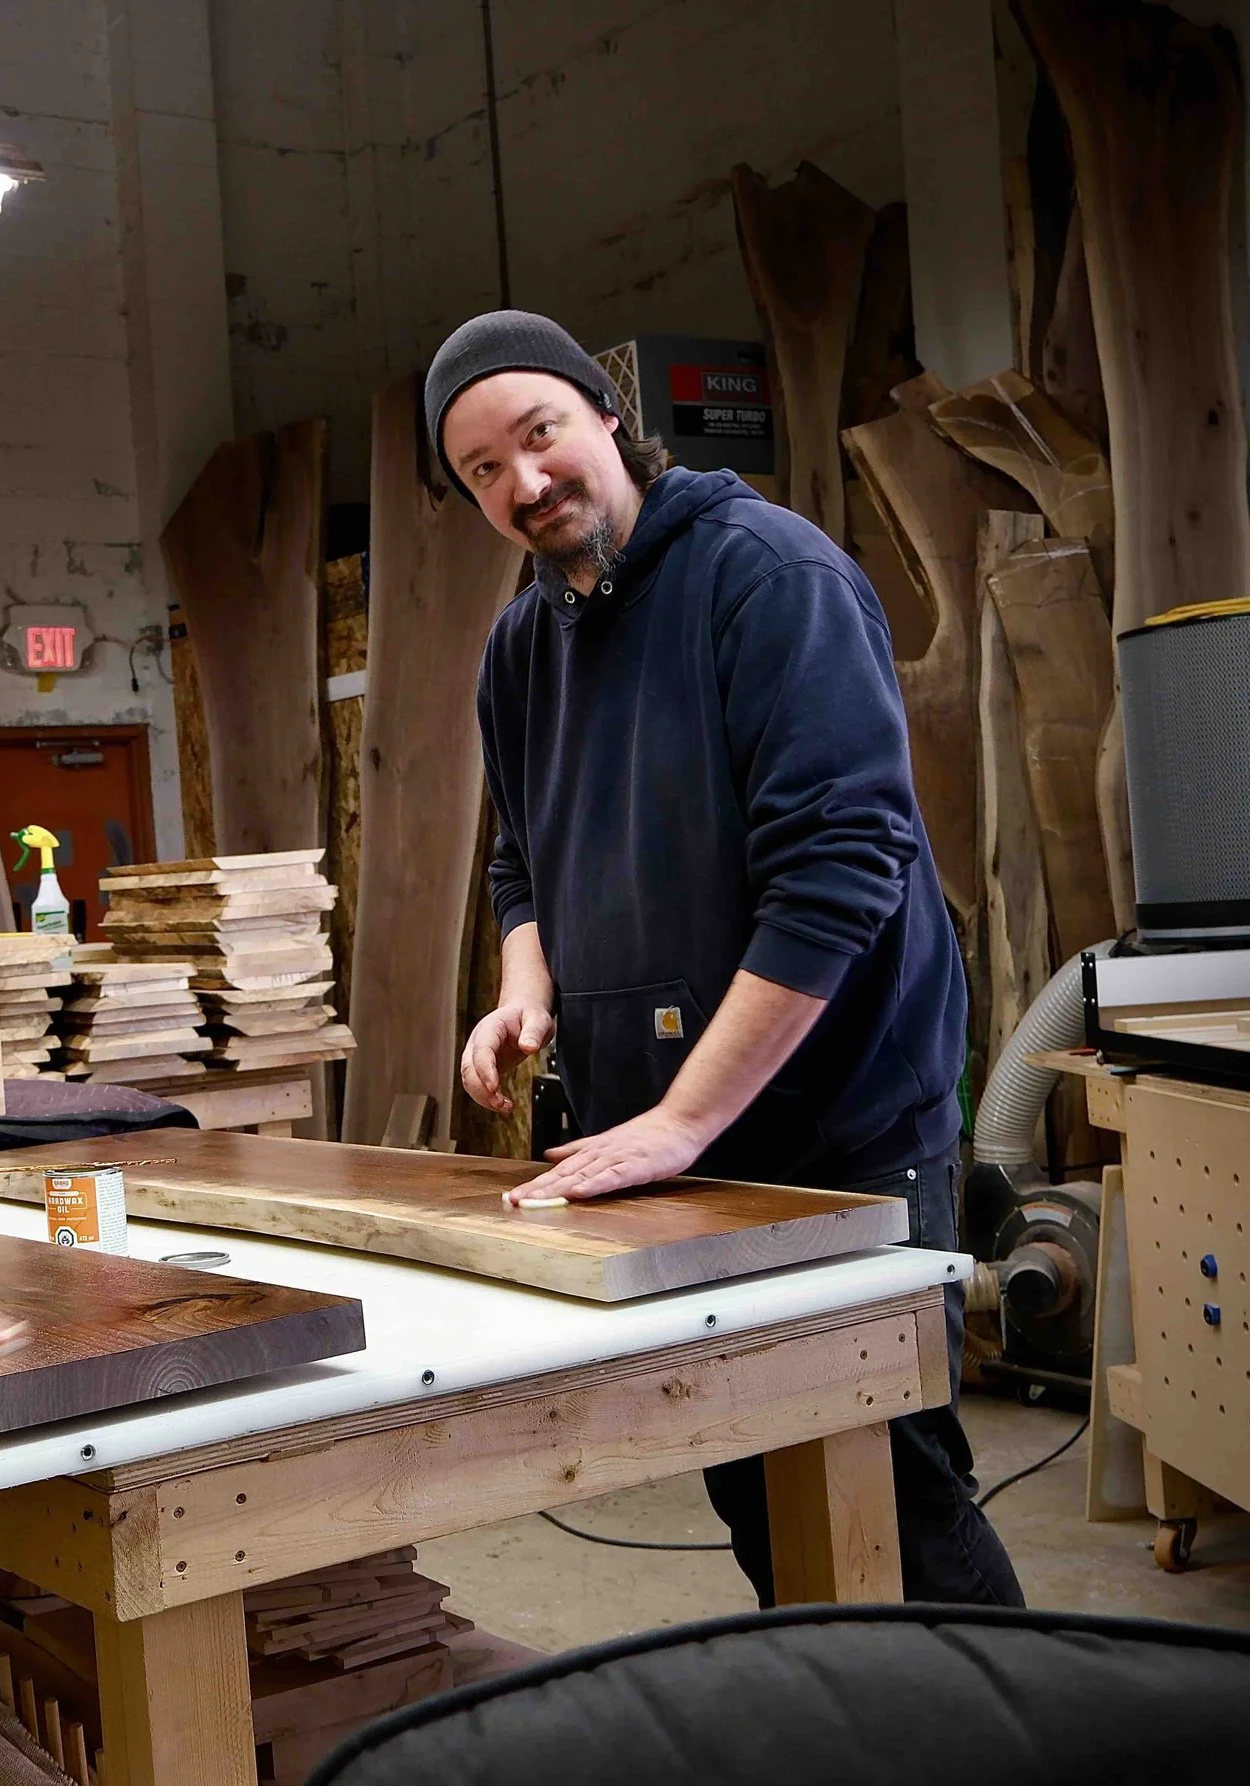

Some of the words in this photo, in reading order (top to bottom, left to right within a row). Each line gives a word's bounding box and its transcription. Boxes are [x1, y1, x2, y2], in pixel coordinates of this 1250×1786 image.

[707, 376, 757, 393] KING
[703, 408, 734, 421] SUPER
[736, 410, 766, 423] TURBO
[27, 627, 75, 668] EXIT
[57, 1205, 70, 1213] OIL
